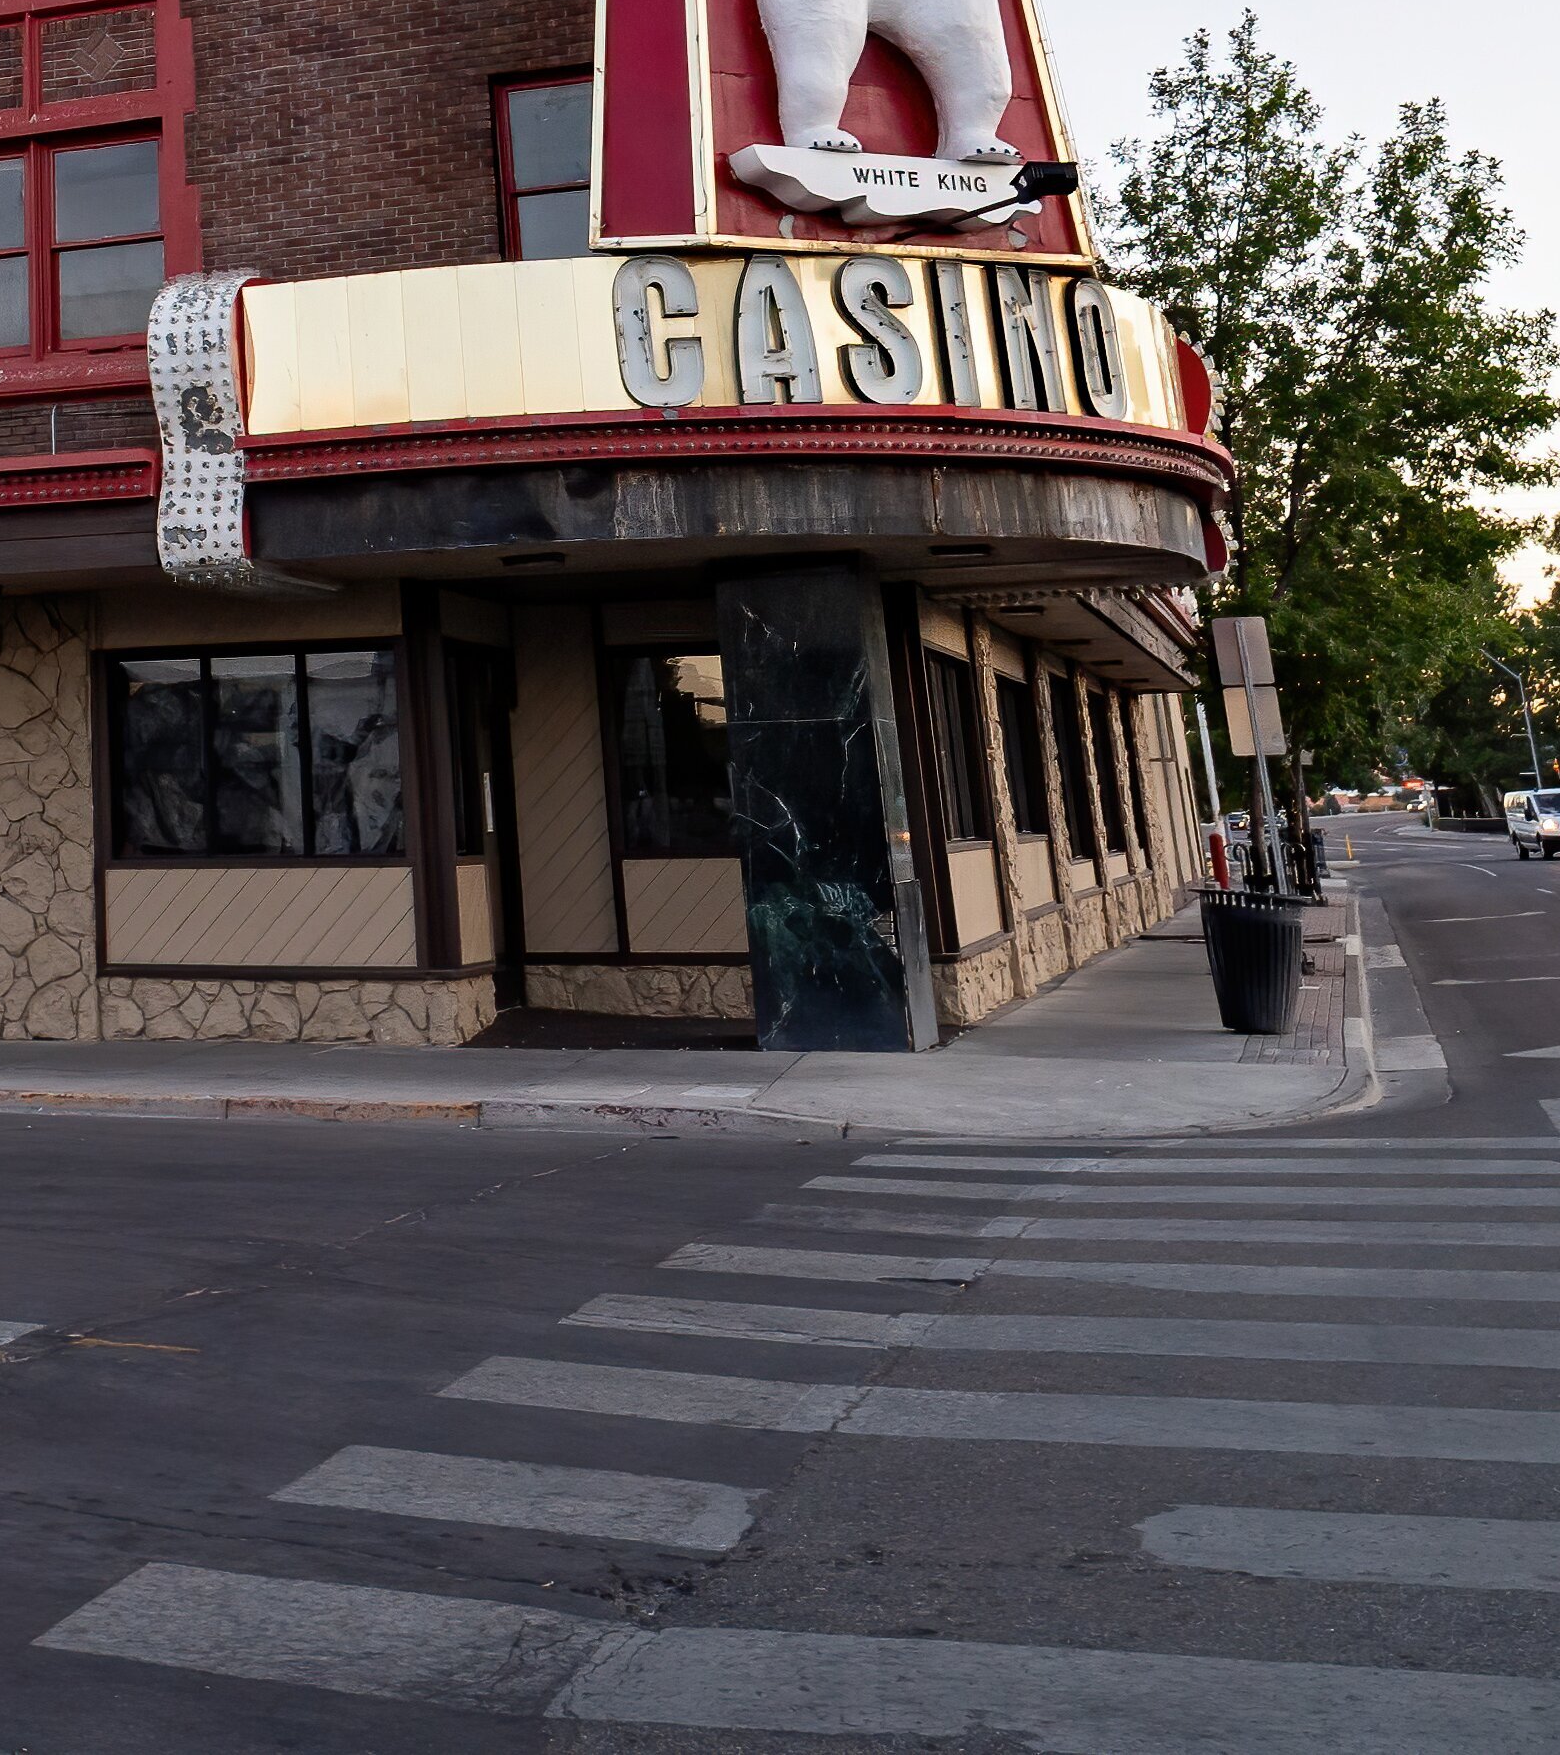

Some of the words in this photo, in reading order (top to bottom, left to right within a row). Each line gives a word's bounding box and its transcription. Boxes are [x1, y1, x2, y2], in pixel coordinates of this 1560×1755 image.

[852, 167, 920, 188] WHITE
[937, 173, 988, 193] KING
[611, 253, 1128, 422] CASINO
